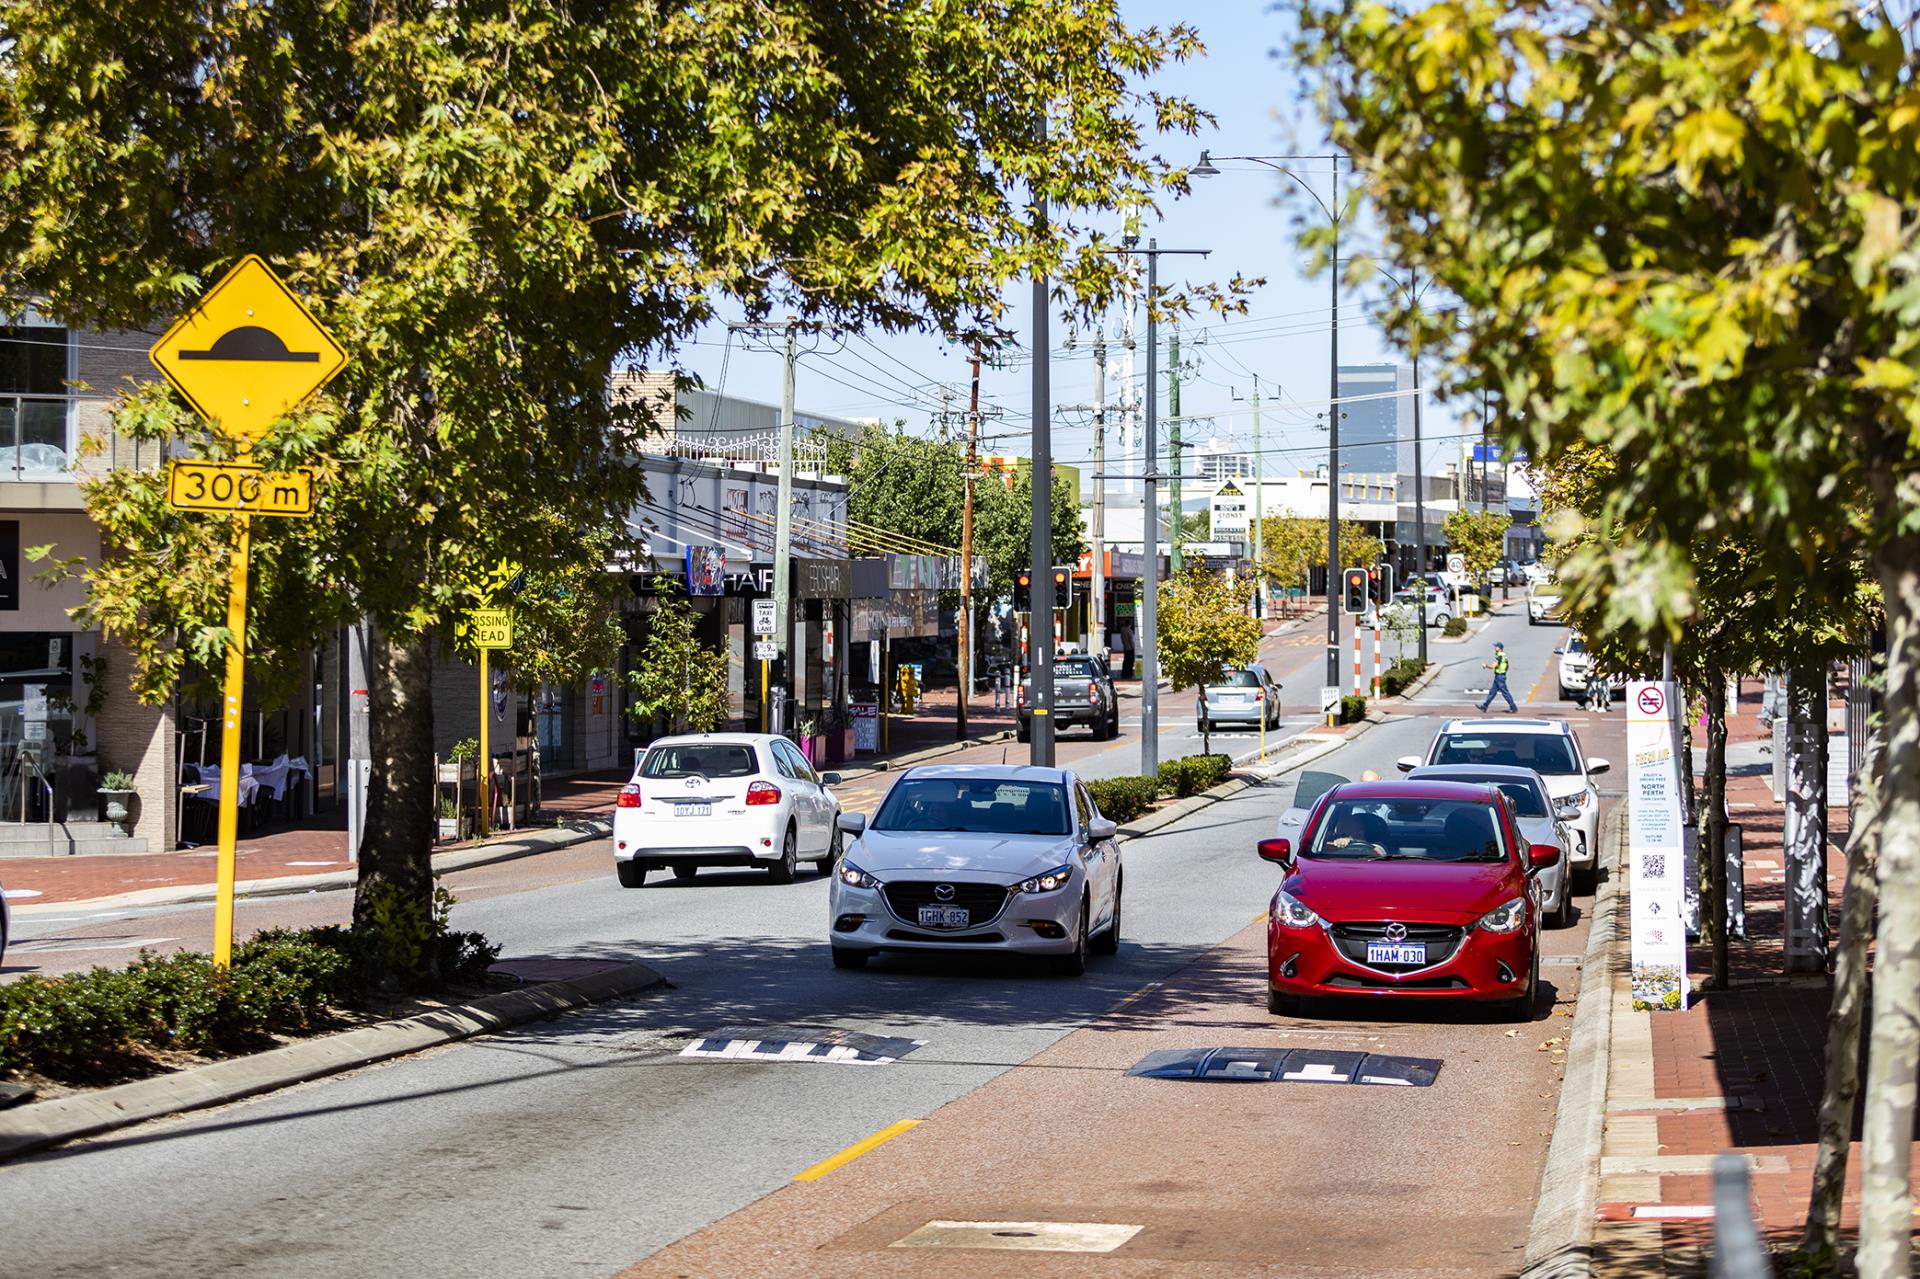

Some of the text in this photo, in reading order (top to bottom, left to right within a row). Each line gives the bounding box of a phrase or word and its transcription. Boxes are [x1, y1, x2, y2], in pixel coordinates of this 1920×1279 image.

[184, 472, 299, 505] 300 m
[1451, 561, 1461, 569] 40
[473, 615, 508, 627] OSSING
[848, 706, 877, 716] SALE
